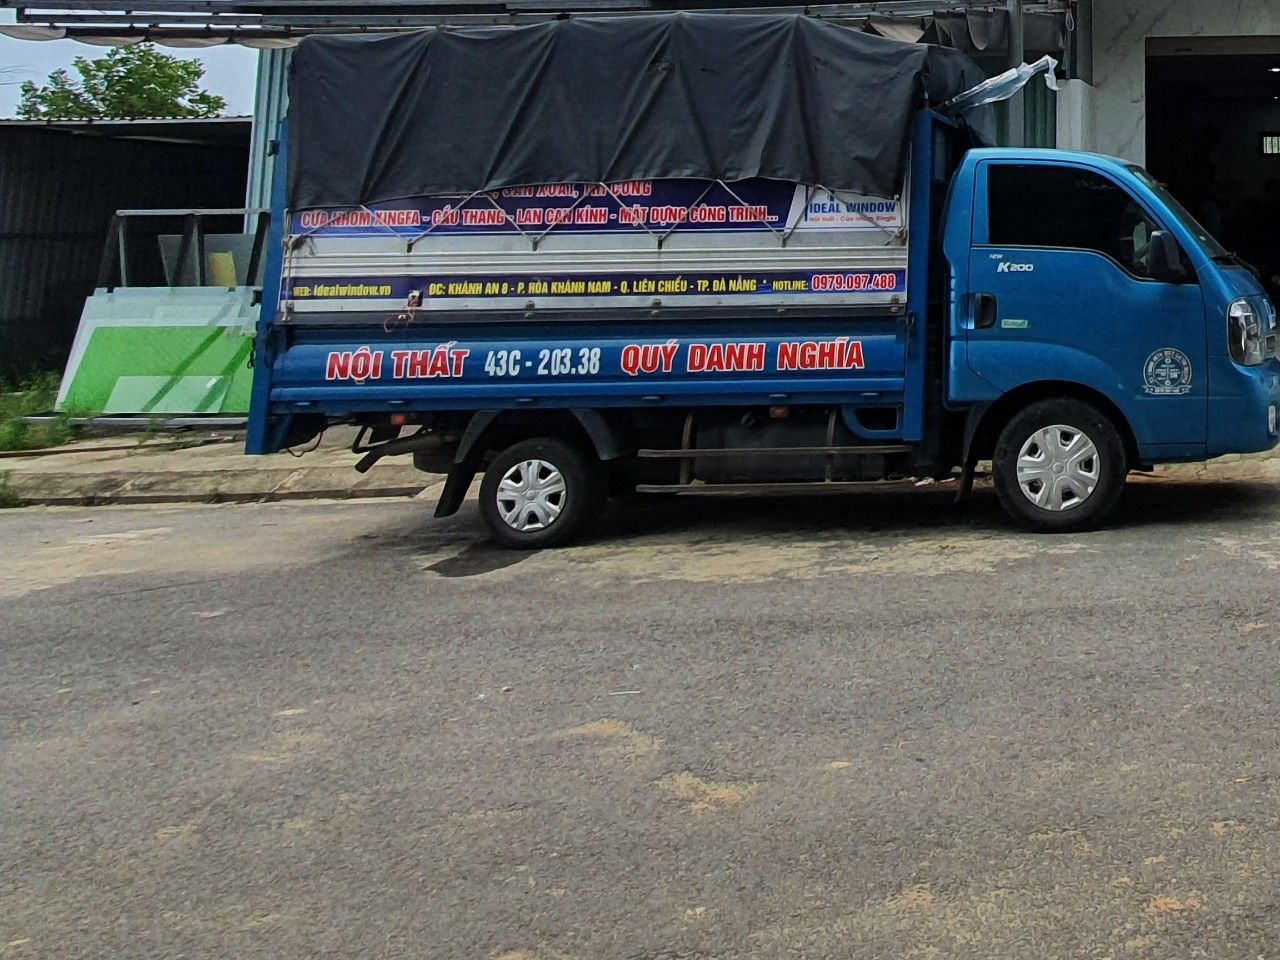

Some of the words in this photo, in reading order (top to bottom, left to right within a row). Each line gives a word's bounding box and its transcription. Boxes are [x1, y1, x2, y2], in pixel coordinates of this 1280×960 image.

[374, 209, 420, 227] XINGFA
[462, 208, 505, 225] THANG
[516, 208, 542, 224] LAN
[575, 205, 609, 224] KÍNH
[690, 203, 726, 223] CÔNG
[809, 202, 841, 213] IDEAL
[845, 202, 896, 213] WINDOW
[996, 262, 1034, 272] K200
[448, 280, 482, 295] KHÁNH
[484, 282, 500, 294] AN
[550, 279, 585, 294] KHÁNH
[587, 281, 611, 293] NAM
[633, 277, 656, 293] LIÊN
[772, 280, 808, 291] HOTLINE:
[812, 273, 896, 291] 0979.097.488
[325, 345, 384, 384] NỘI
[391, 340, 470, 379] THẤT
[484, 350, 520, 376] 43C
[537, 347, 601, 376] 203.38
[620, 339, 681, 376] QUÝ
[686, 341, 766, 372] DANH
[776, 336, 865, 371] NGHĨA
